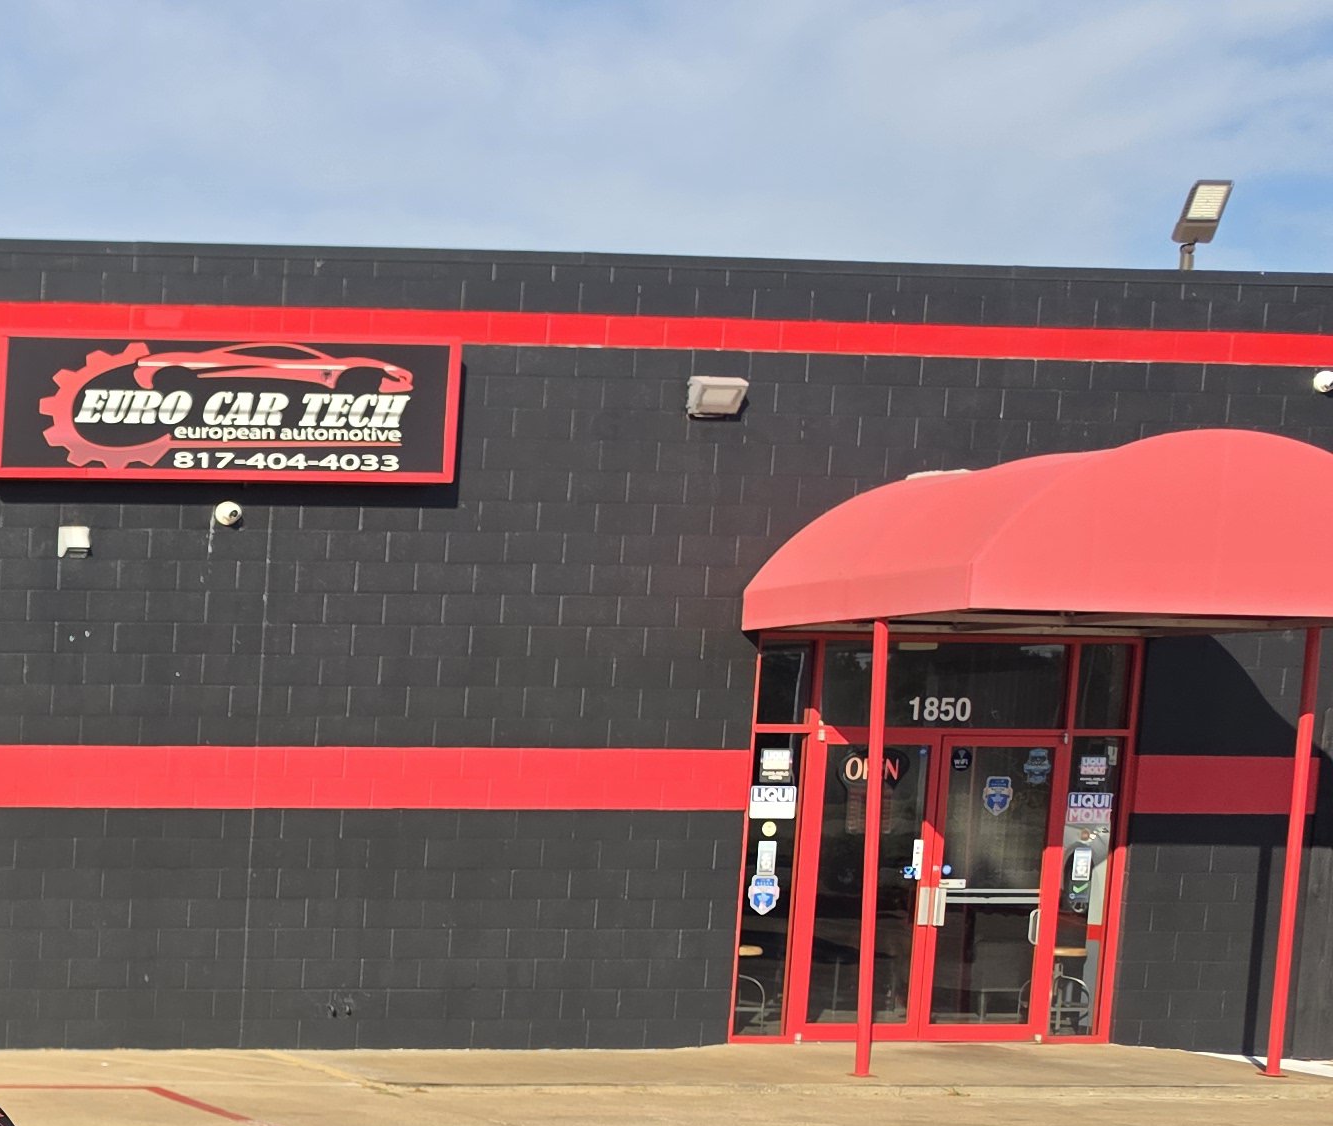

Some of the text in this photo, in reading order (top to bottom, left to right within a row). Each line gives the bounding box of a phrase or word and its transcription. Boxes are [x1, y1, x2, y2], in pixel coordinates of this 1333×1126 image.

[74, 389, 411, 428] EURO CAR TECH
[173, 425, 402, 443] european automotive
[173, 451, 400, 472] 817-404-4033
[909, 696, 972, 722] 1850
[845, 757, 899, 781] ON
[753, 787, 794, 802] LIQUI
[1070, 794, 1111, 808] LIQUI
[1068, 808, 1111, 823] MOLY
